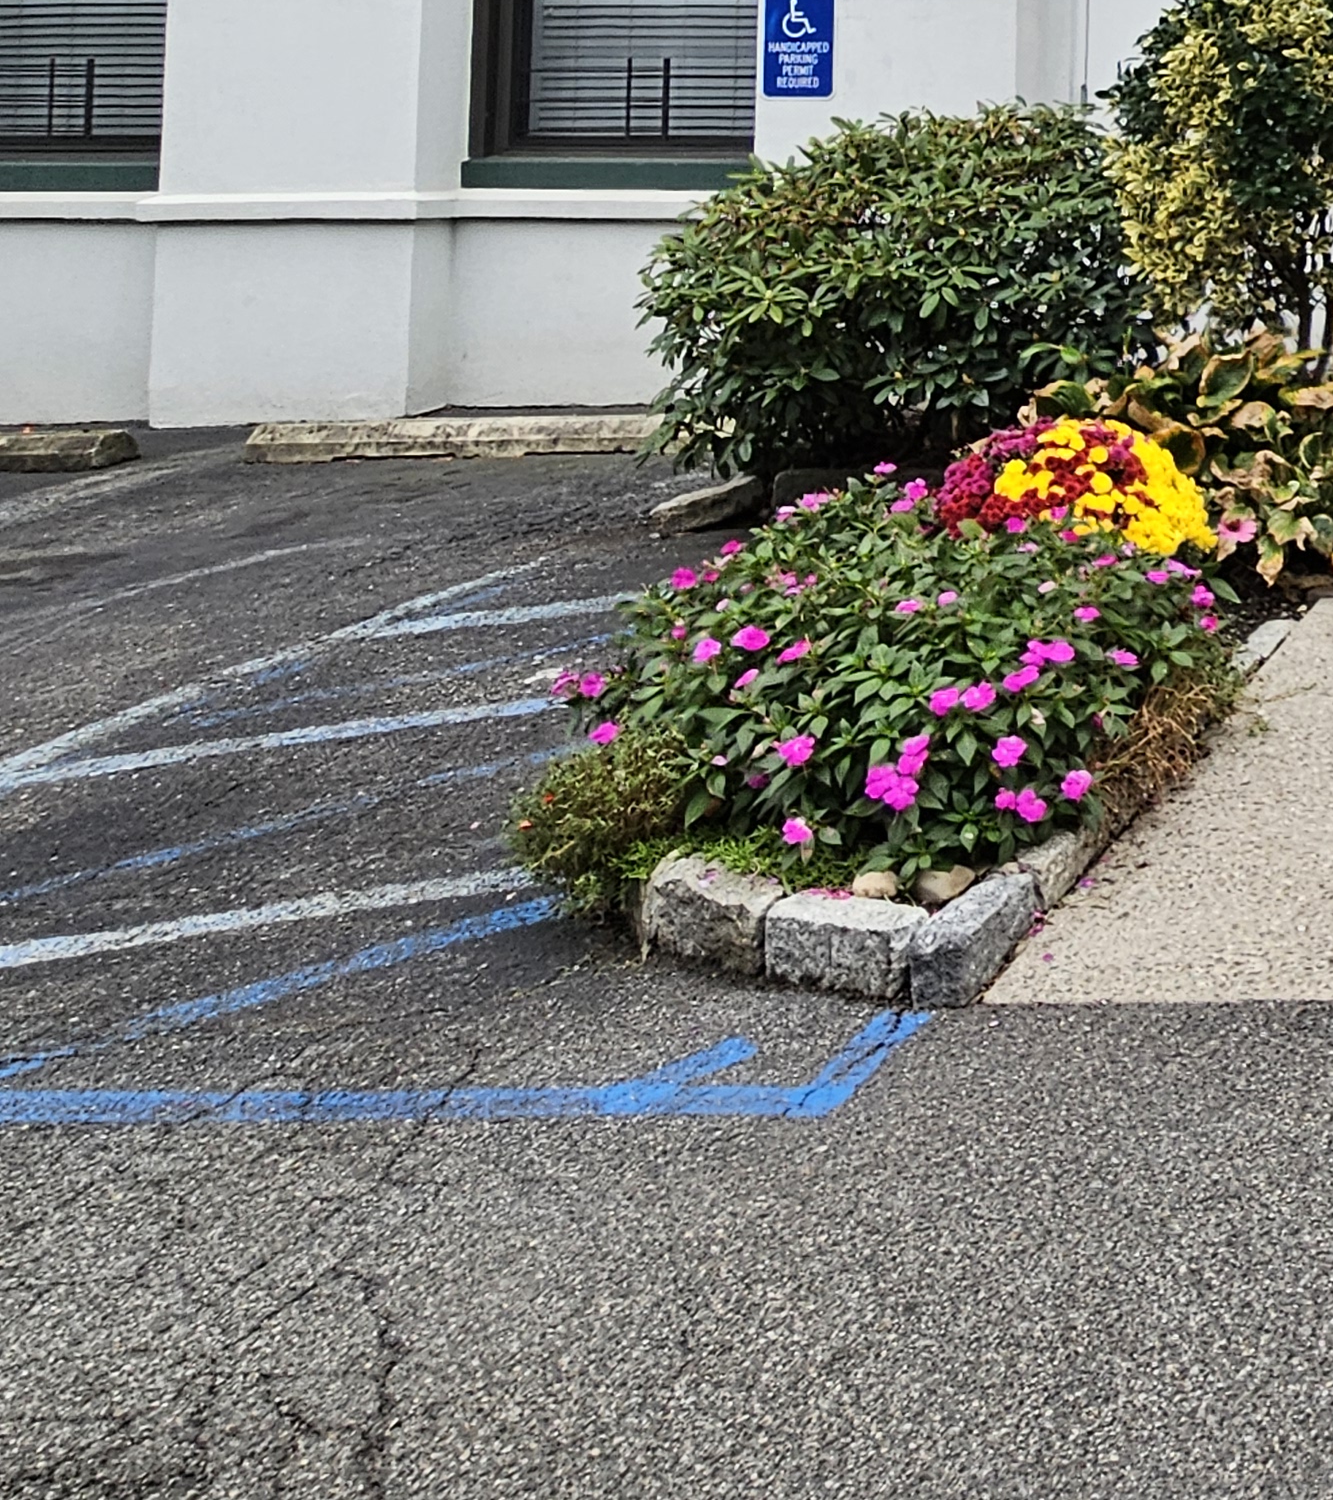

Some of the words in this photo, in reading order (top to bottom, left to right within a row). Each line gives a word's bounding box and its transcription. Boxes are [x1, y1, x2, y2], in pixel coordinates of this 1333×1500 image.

[768, 41, 830, 53] HANDICAPPED
[778, 53, 819, 65] PARKING
[782, 65, 814, 76] PERMIT
[776, 76, 820, 88] REQUIRED
